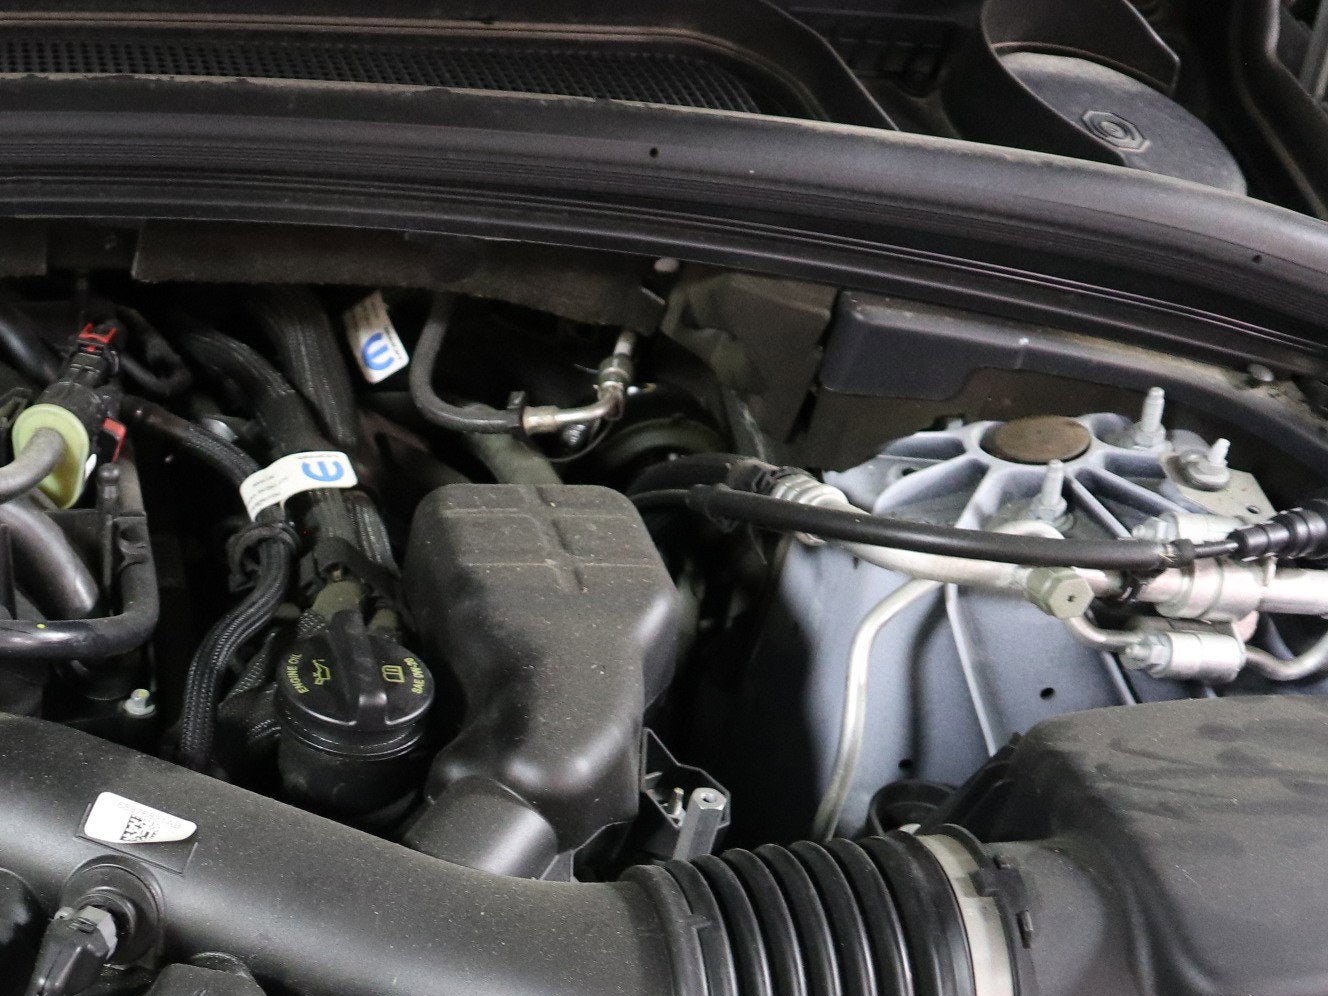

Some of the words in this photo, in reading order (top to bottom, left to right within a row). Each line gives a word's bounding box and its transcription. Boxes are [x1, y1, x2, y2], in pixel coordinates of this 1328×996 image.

[288, 653, 304, 665] OIL
[403, 657, 425, 680] 0W-20
[285, 665, 310, 694] ENGINE
[411, 679, 426, 694] SAE
